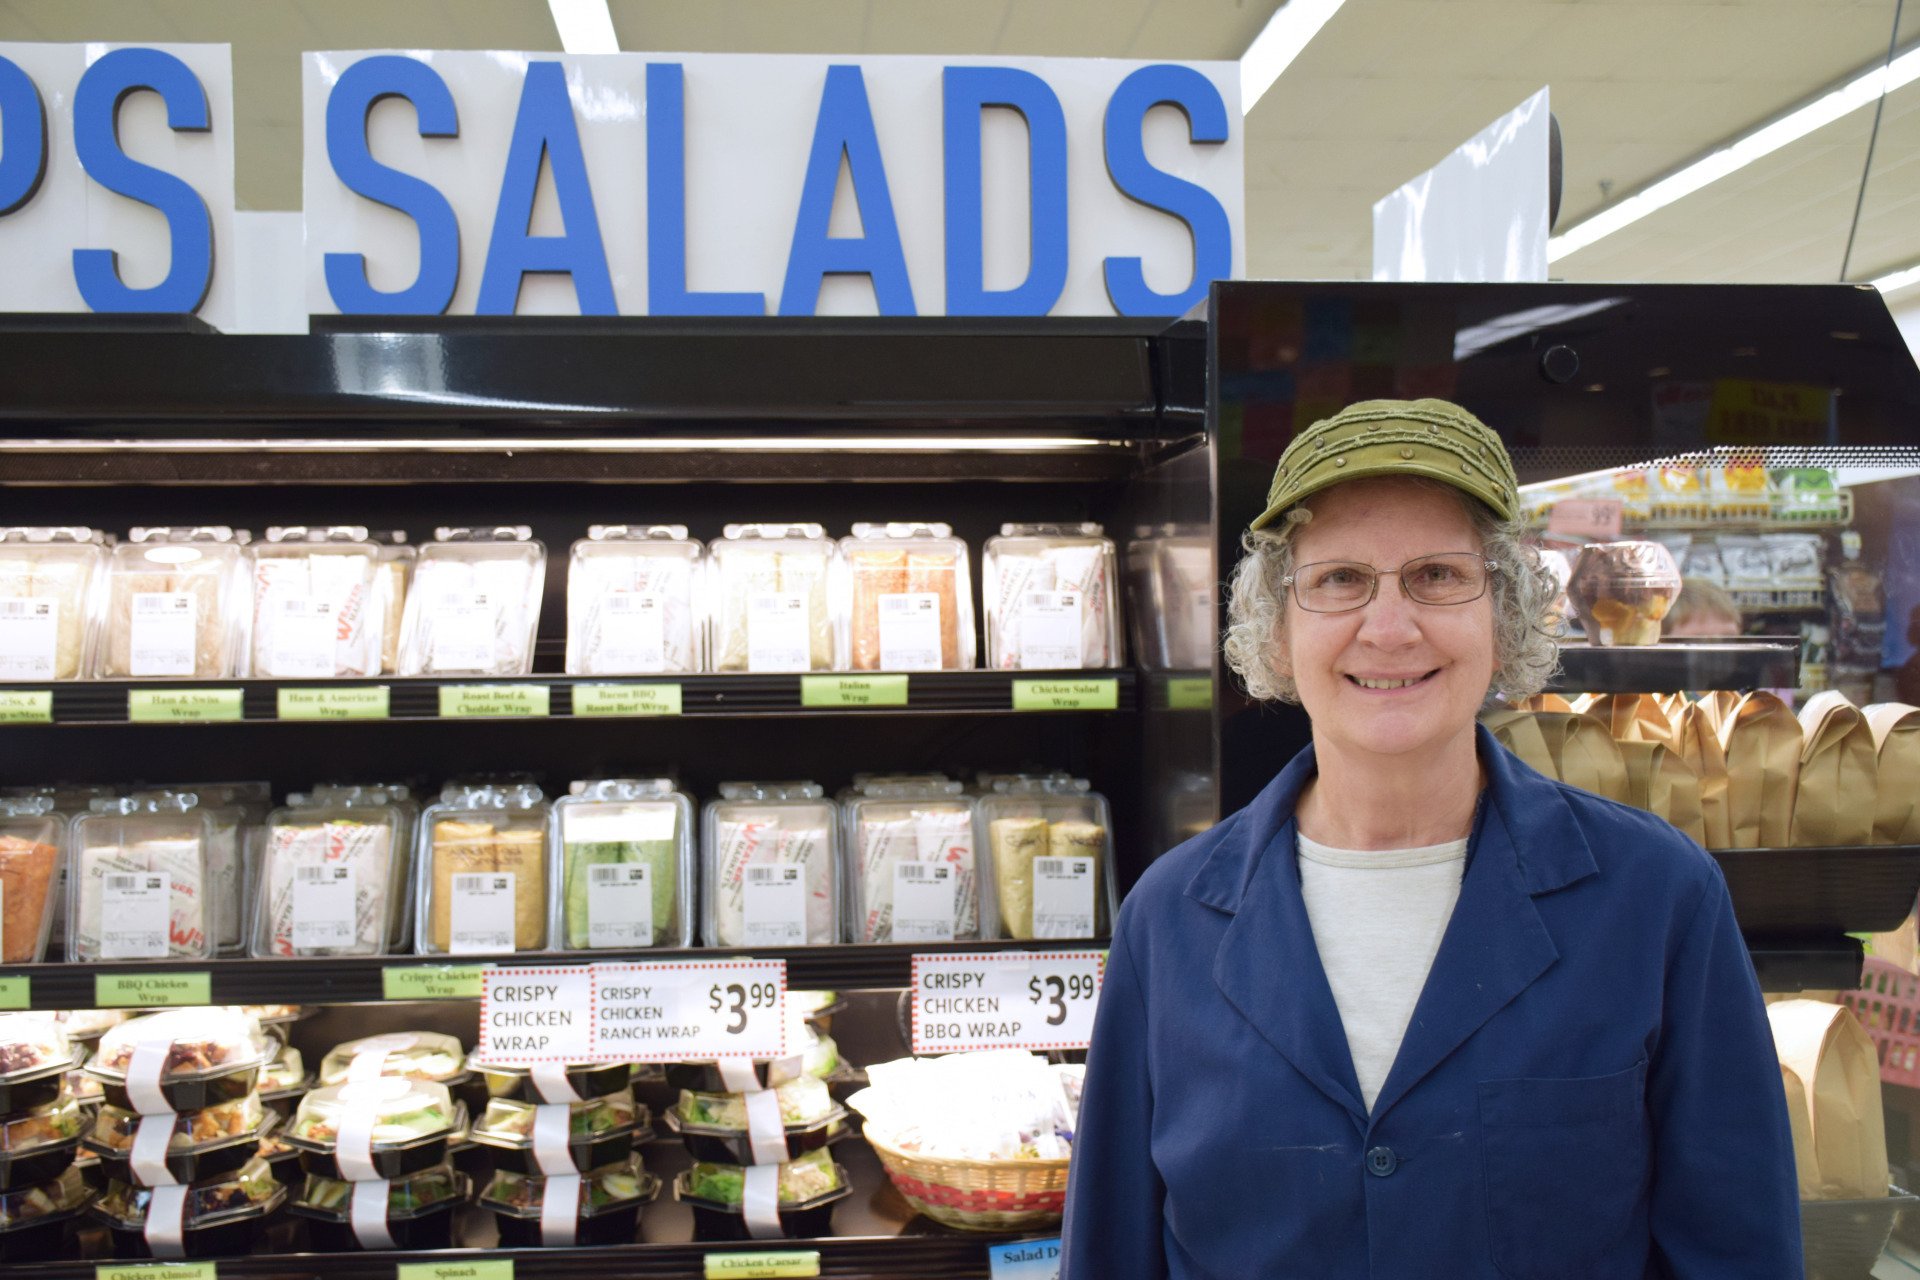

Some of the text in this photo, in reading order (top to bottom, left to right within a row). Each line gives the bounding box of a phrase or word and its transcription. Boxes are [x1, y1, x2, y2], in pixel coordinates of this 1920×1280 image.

[323, 54, 1233, 317] SALADS
[839, 681, 871, 690] Italian
[1031, 684, 1099, 695] Chicken Salad
[151, 695, 219, 705] Ham & Swiss
[289, 693, 378, 703] Ham & American
[462, 691, 526, 701] Roast Beef &
[599, 689, 656, 700] Bacon BBQ
[842, 693, 869, 703] Wrap
[457, 703, 532, 714] Cheddar Wrap
[586, 702, 670, 713] Roast Beef Wrap
[1052, 698, 1080, 708] Wrap
[172, 707, 201, 718] Wrap
[319, 706, 349, 717] Wrap
[400, 972, 480, 983] Crispy Chicken
[923, 972, 985, 989] CRISPY
[117, 979, 189, 991] BBQ Chicken
[426, 985, 456, 995] Wrap
[138, 992, 168, 1003] Wrap
[493, 985, 559, 1003] CRISPY
[601, 986, 652, 1000] CRISPY
[924, 997, 999, 1014] CHICKEN
[493, 1010, 572, 1027] CHICKEN
[601, 1007, 663, 1021] CHICKEN
[601, 1025, 701, 1040] RANCH WRAP
[924, 1021, 1021, 1039] BBQ WRAP
[493, 1036, 549, 1050] WRAP
[1003, 1247, 1043, 1264] Salad
[721, 1257, 801, 1268] Chicken Caesar
[110, 1269, 202, 1280] Chicken Almond
[435, 1267, 477, 1279] Spinach
